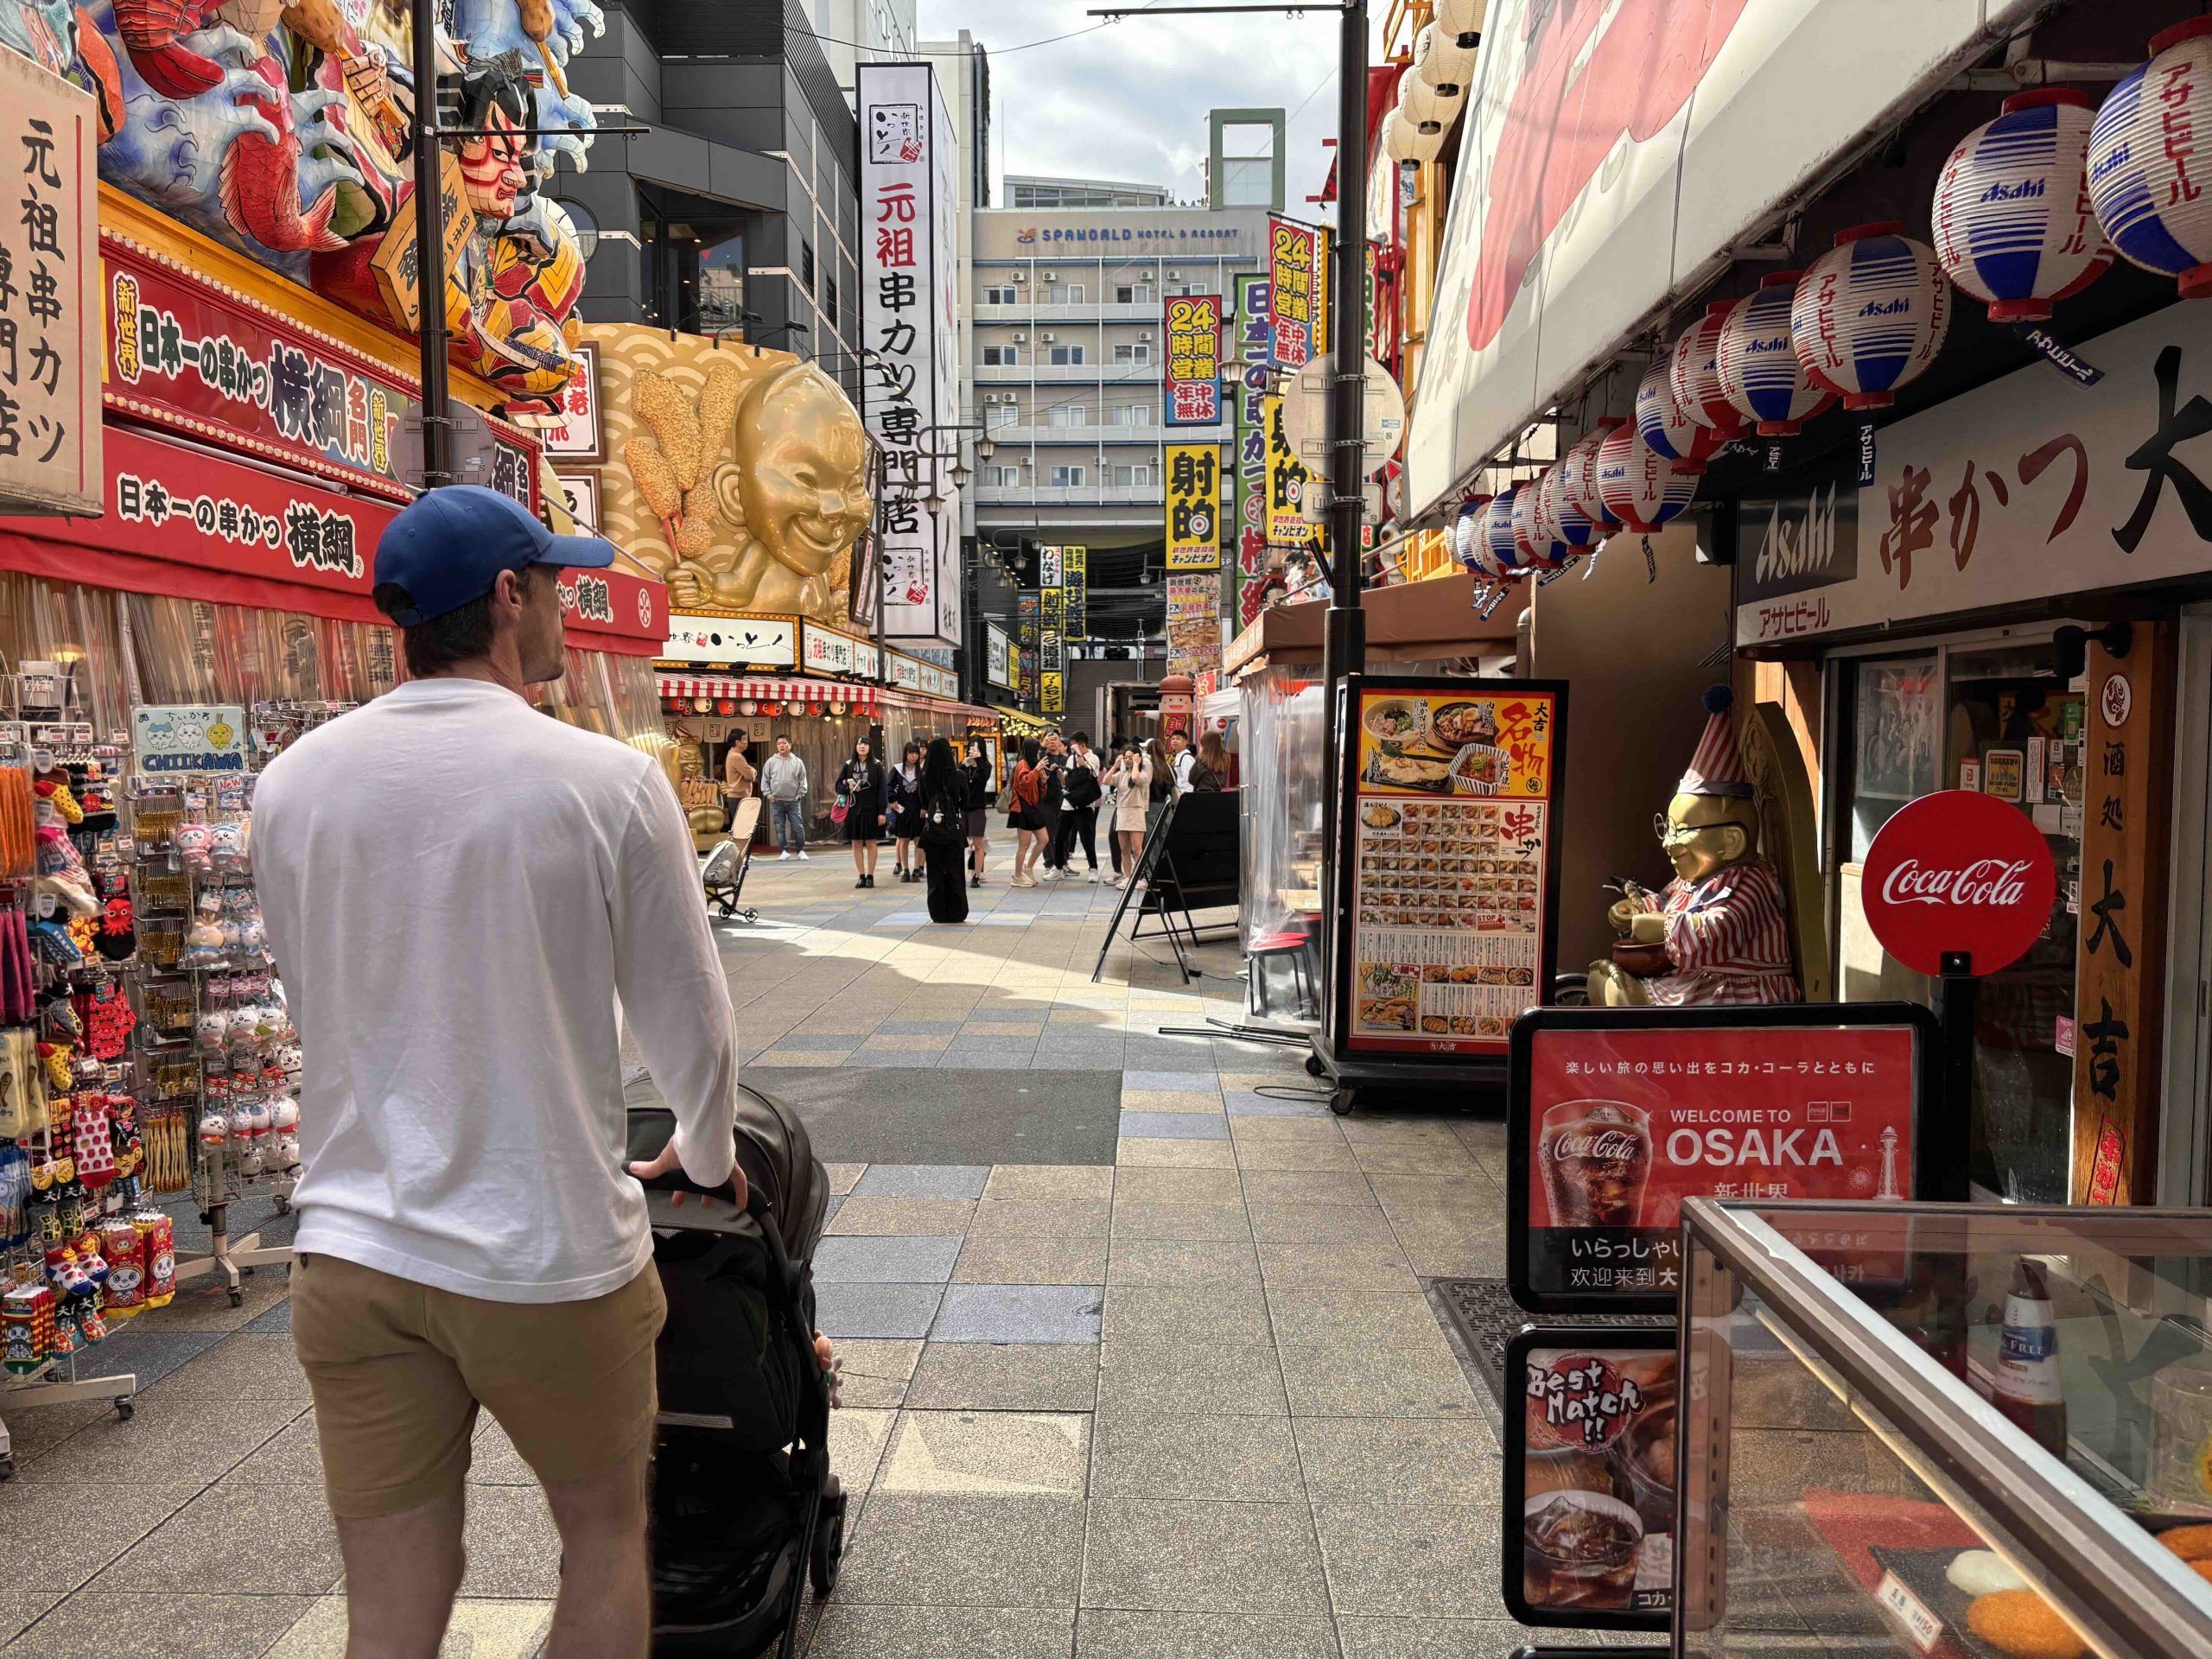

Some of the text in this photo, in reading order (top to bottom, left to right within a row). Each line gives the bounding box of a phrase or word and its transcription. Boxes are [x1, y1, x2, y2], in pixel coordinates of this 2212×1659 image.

[2158, 61, 2202, 207] アサヒビール
[2091, 142, 2131, 183] Asahi
[1936, 147, 1967, 267] アサヒビール
[1980, 177, 2046, 203] Asahi
[1042, 228, 1131, 242] SPAWORLD
[1274, 228, 1313, 270] 24
[21, 118, 66, 463] 元祖串カツ
[1274, 262, 1310, 296] 時間
[1170, 301, 1216, 333] 24
[1274, 290, 1310, 324] 営業
[1816, 272, 1844, 370] アサヒビール
[1859, 297, 1910, 318] Asahi
[1915, 261, 1945, 360] アサヒビール
[117, 276, 138, 380] 新世界
[1171, 333, 1215, 356] 時間
[1275, 321, 1307, 344] 年中
[1745, 335, 1789, 353] Asahi
[1171, 357, 1216, 381] 営業
[1275, 341, 1307, 366] 無休
[1174, 384, 1214, 401] 年中
[1174, 402, 1214, 420] 無休
[1859, 423, 1873, 481] アサヒビール
[1171, 450, 1216, 543] 射的
[1879, 432, 2089, 592] 串かつ
[1272, 525, 1309, 537] チャンピオン
[1755, 480, 1837, 586] Asahi
[1171, 553, 1217, 564] チャンピオン
[1758, 596, 1831, 639] アサヒビール
[164, 711, 211, 723] ちいかわ
[1533, 702, 1550, 732] 大吉
[1495, 701, 1546, 777] 名物
[142, 752, 245, 772] CHIIKAWA
[2101, 741, 2126, 832] 酒処
[1499, 804, 1541, 861] 串かつ
[1882, 858, 2034, 906] Coca-Cola
[2085, 858, 2133, 1102] 大吉
[1565, 1060, 1876, 1076] 楽しい旅の思い出をコカ・コーラとともに
[1670, 1109, 1791, 1124] WELCOME TO
[1554, 1130, 1641, 1162] Coca-Cola
[1666, 1128, 1843, 1166] OSAKA
[1713, 1182, 1789, 1198] 新世界
[1527, 1360, 1603, 1397] Best
[1547, 1381, 1641, 1425] Match
